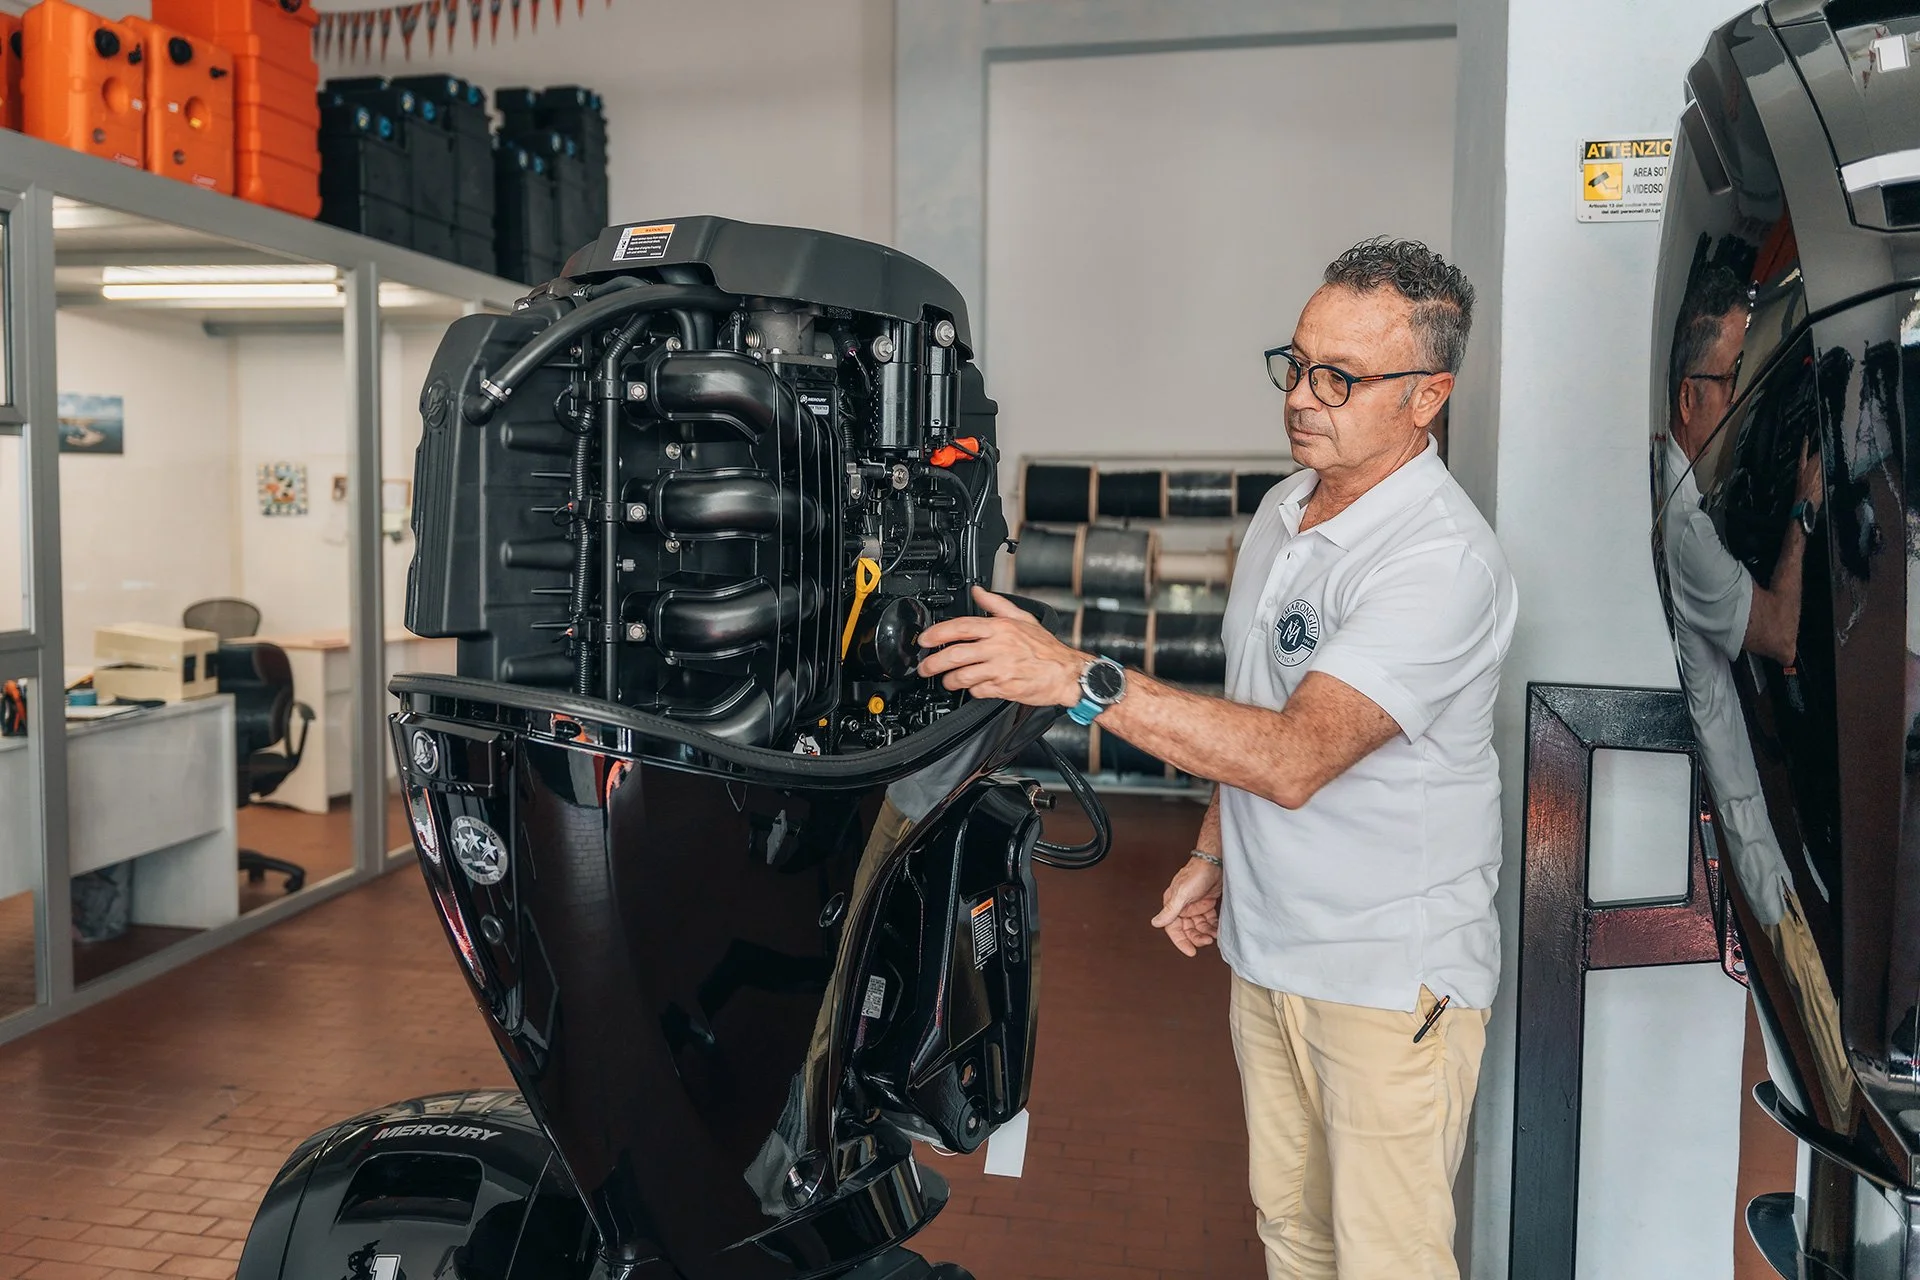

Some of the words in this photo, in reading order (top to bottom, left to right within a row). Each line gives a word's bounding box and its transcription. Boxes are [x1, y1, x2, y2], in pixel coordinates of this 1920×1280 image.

[1633, 168, 1653, 177] AREA
[1626, 185, 1631, 194] A
[1633, 184, 1664, 194] VIDEOSO
[479, 823, 497, 840] LOW
[373, 1124, 502, 1140] MERCURY
